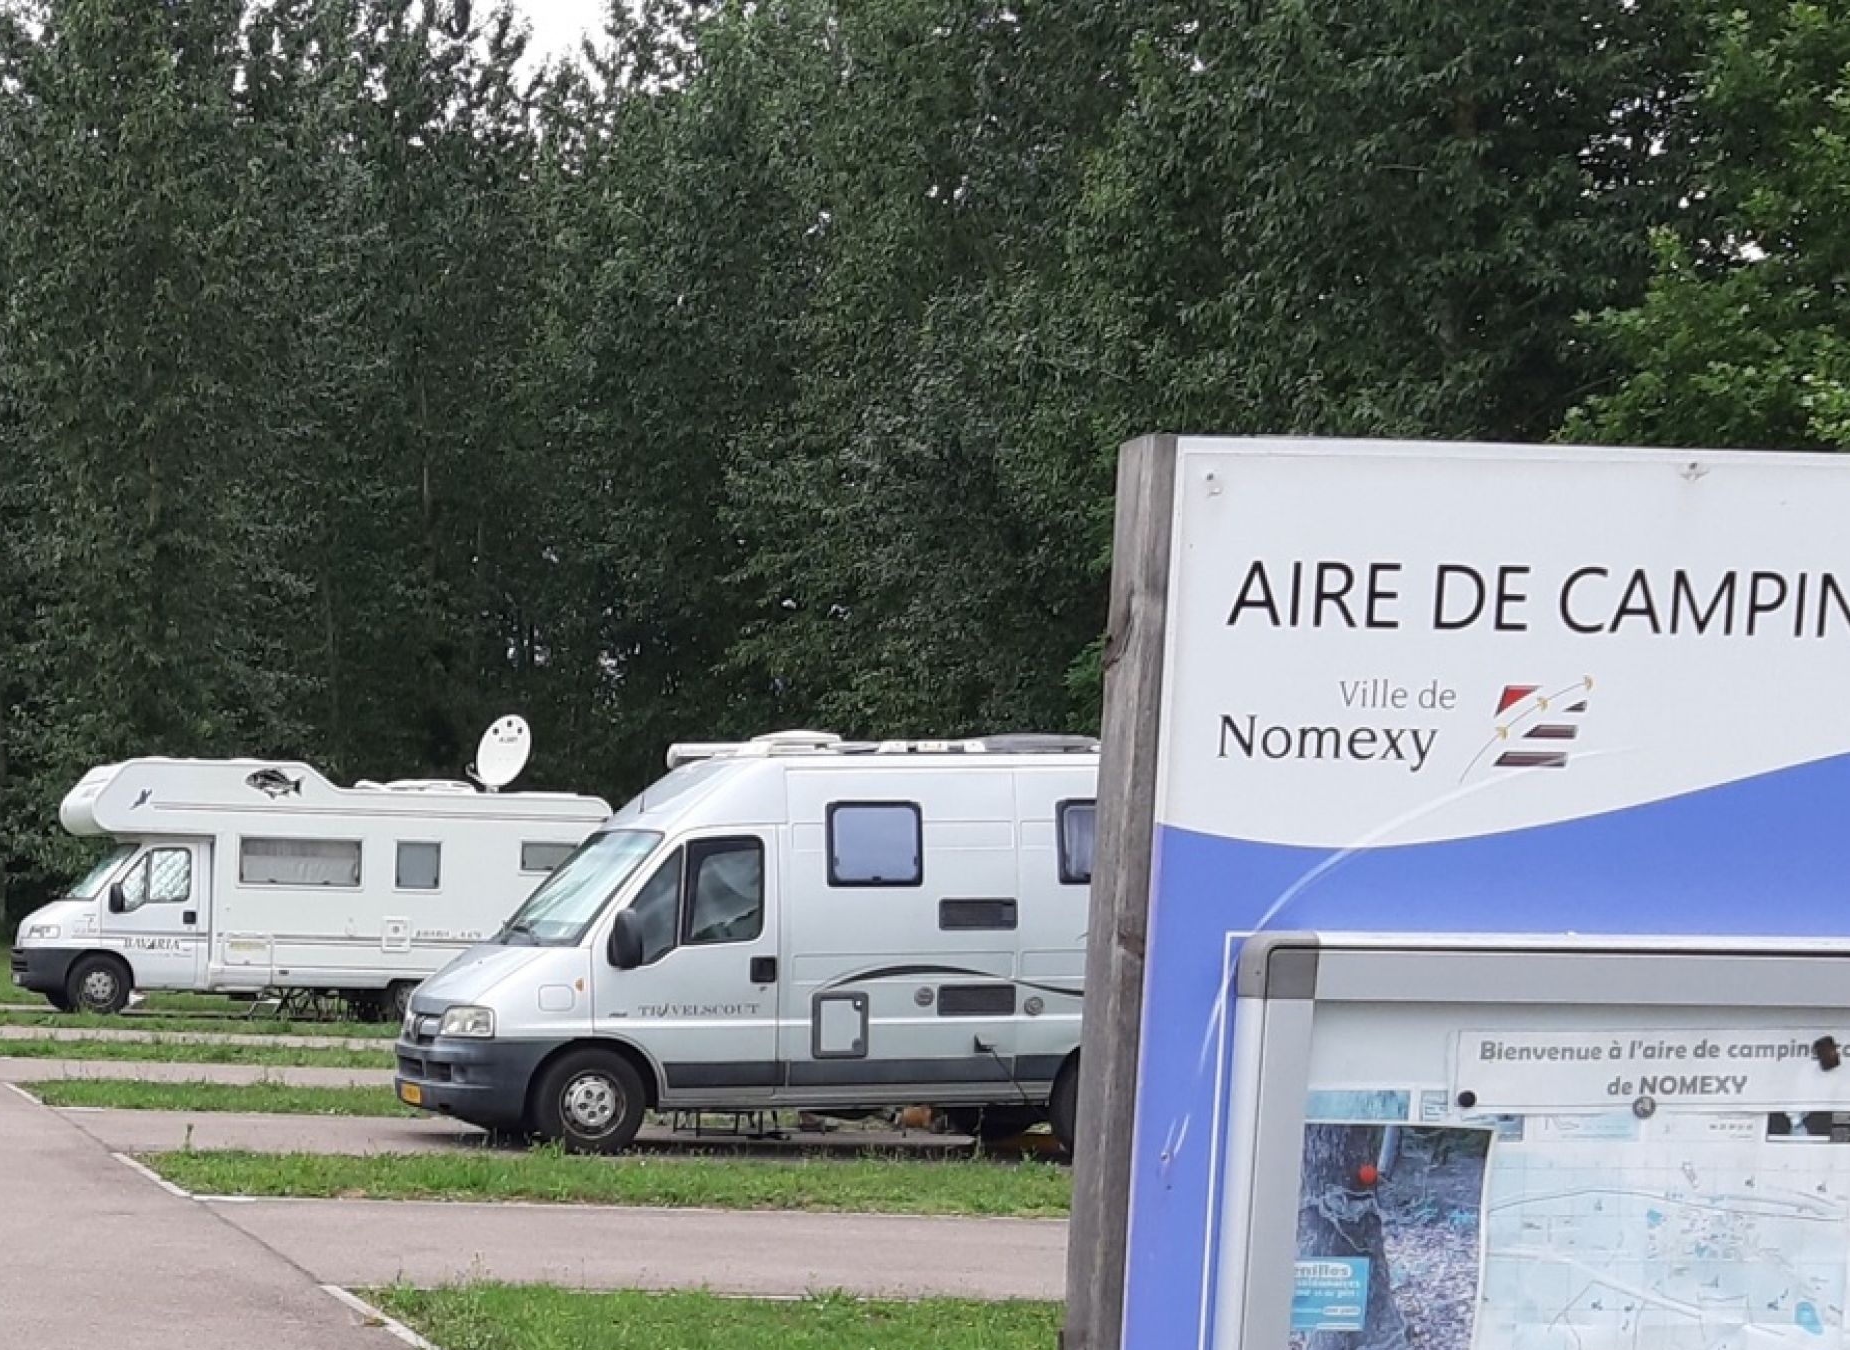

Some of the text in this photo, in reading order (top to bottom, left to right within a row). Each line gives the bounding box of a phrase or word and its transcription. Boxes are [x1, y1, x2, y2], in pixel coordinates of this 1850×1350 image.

[1226, 560, 1402, 629] AIRE
[1433, 563, 1531, 632] DE
[1338, 679, 1457, 710] Ville de
[1217, 714, 1439, 772] Nomexy
[1480, 1040, 1602, 1061] Bienvenue
[1607, 1040, 1622, 1060] à
[1628, 1040, 1687, 1061] l'aire
[1692, 1039, 1721, 1060] de
[1607, 1075, 1748, 1096] de NOMEXY
